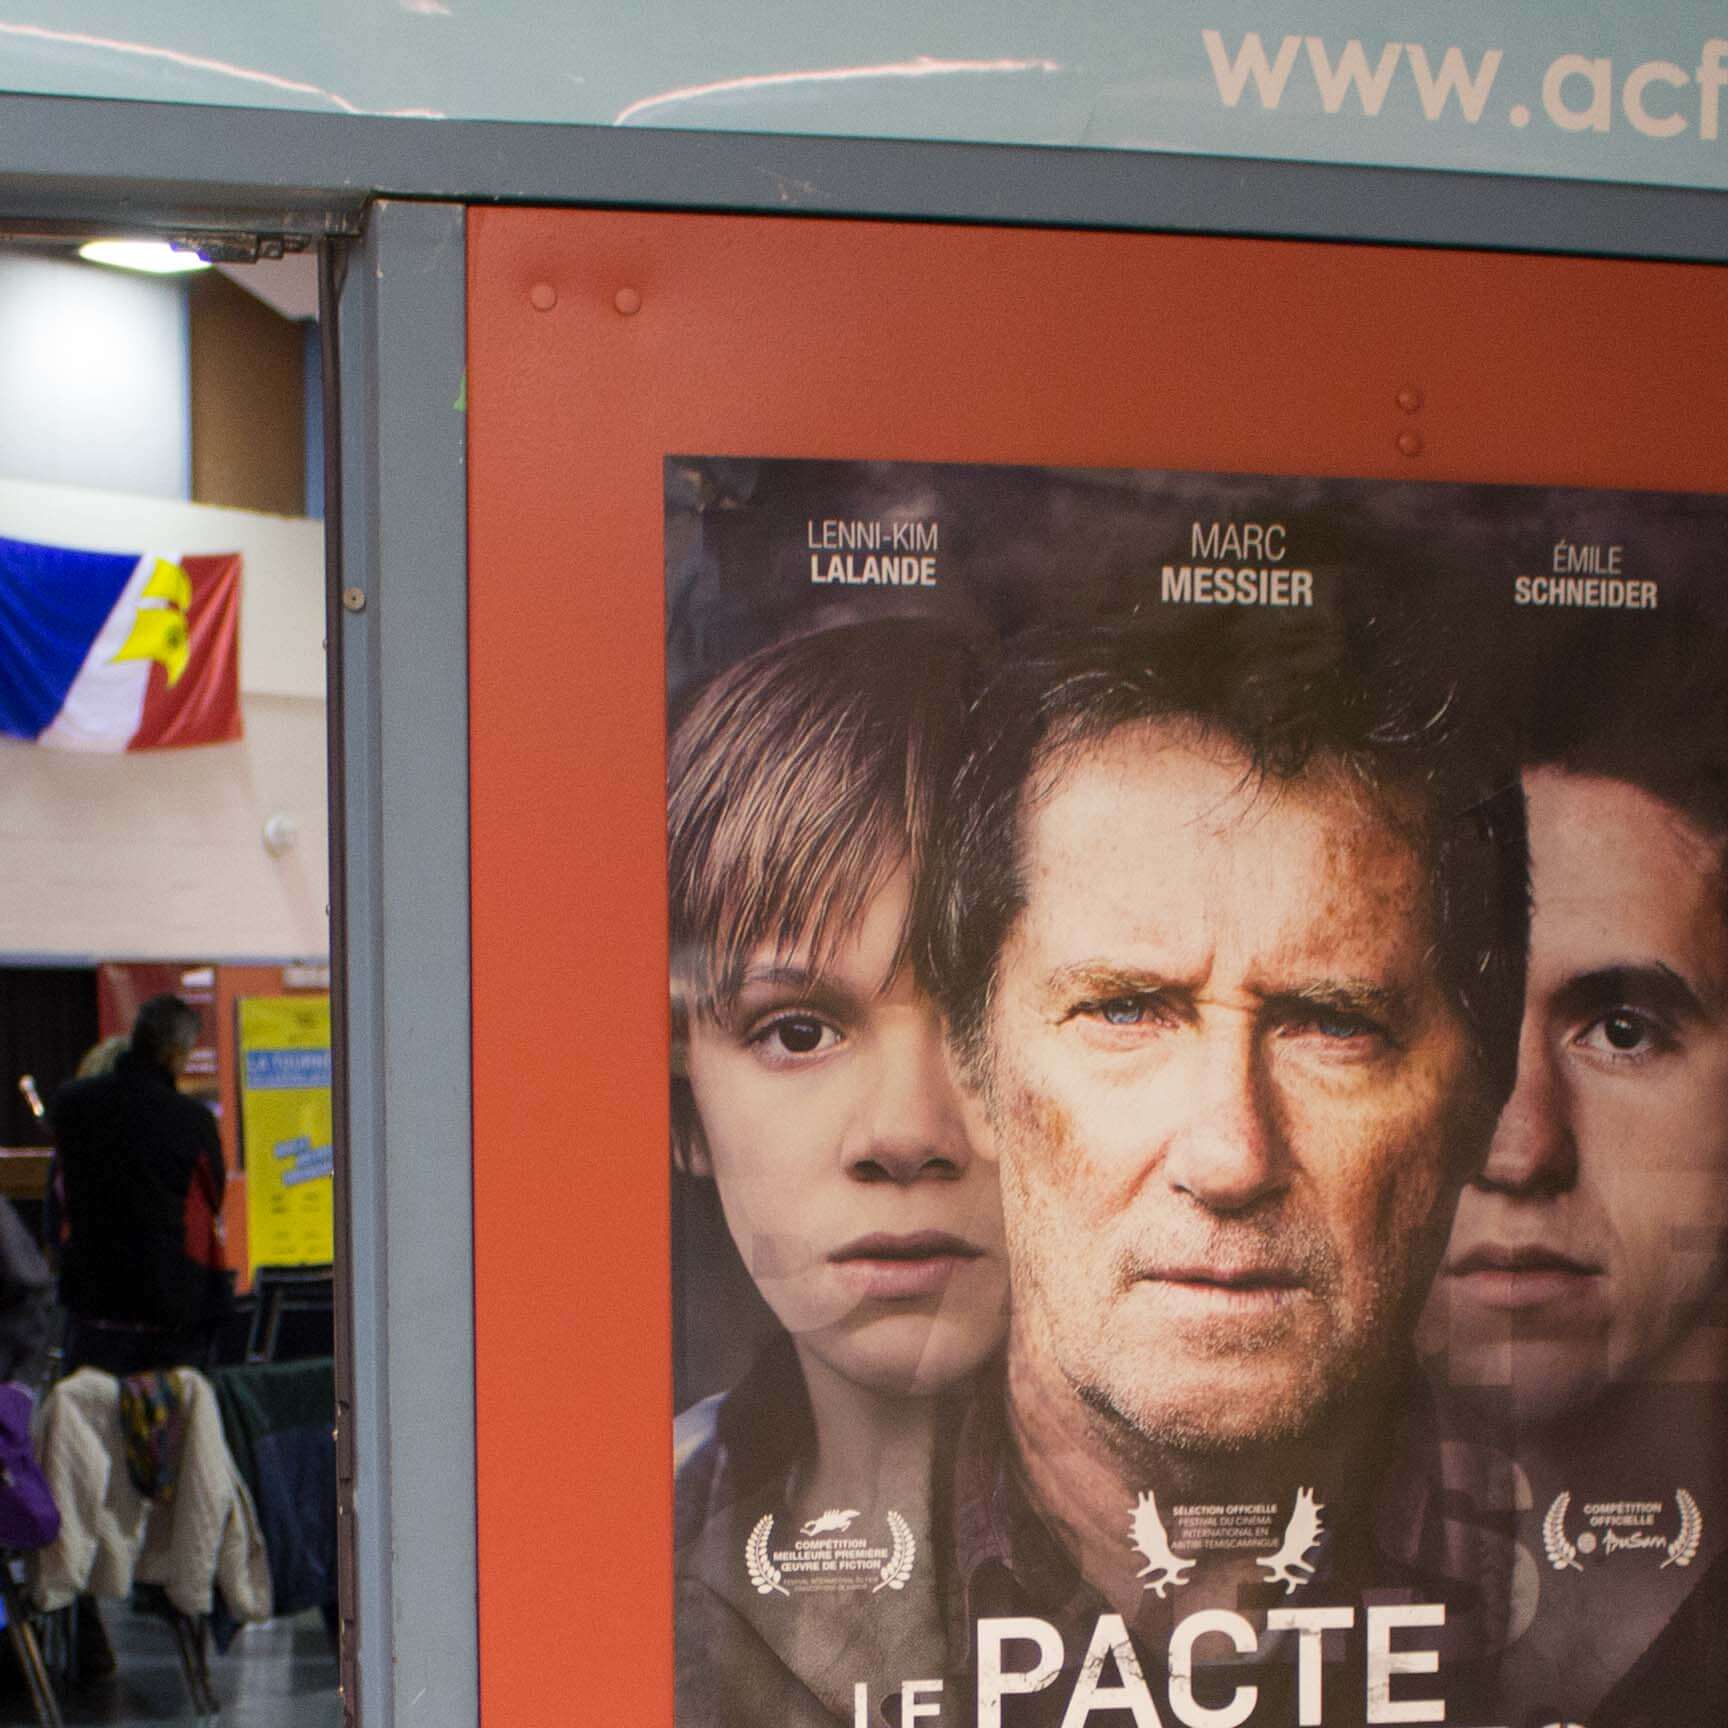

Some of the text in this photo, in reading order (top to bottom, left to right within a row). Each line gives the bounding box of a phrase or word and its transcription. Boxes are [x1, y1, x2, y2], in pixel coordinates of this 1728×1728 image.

[808, 519, 939, 552] LENNI-KIM
[1191, 522, 1286, 562] MARC
[810, 554, 936, 587] LALANDE
[1553, 540, 1621, 575] ÉMILE
[1160, 567, 1313, 607] MESSIER
[1514, 577, 1658, 610] SCHNEIDER
[1226, 1503, 1278, 1515] OFFICIELLE
[1590, 1514, 1654, 1527] OFFICIELLE
[773, 1550, 833, 1562] MEILLEURE
[795, 1538, 868, 1551] COMPÉTITION
[822, 1560, 837, 1571] DE
[839, 1558, 882, 1571] FICTION
